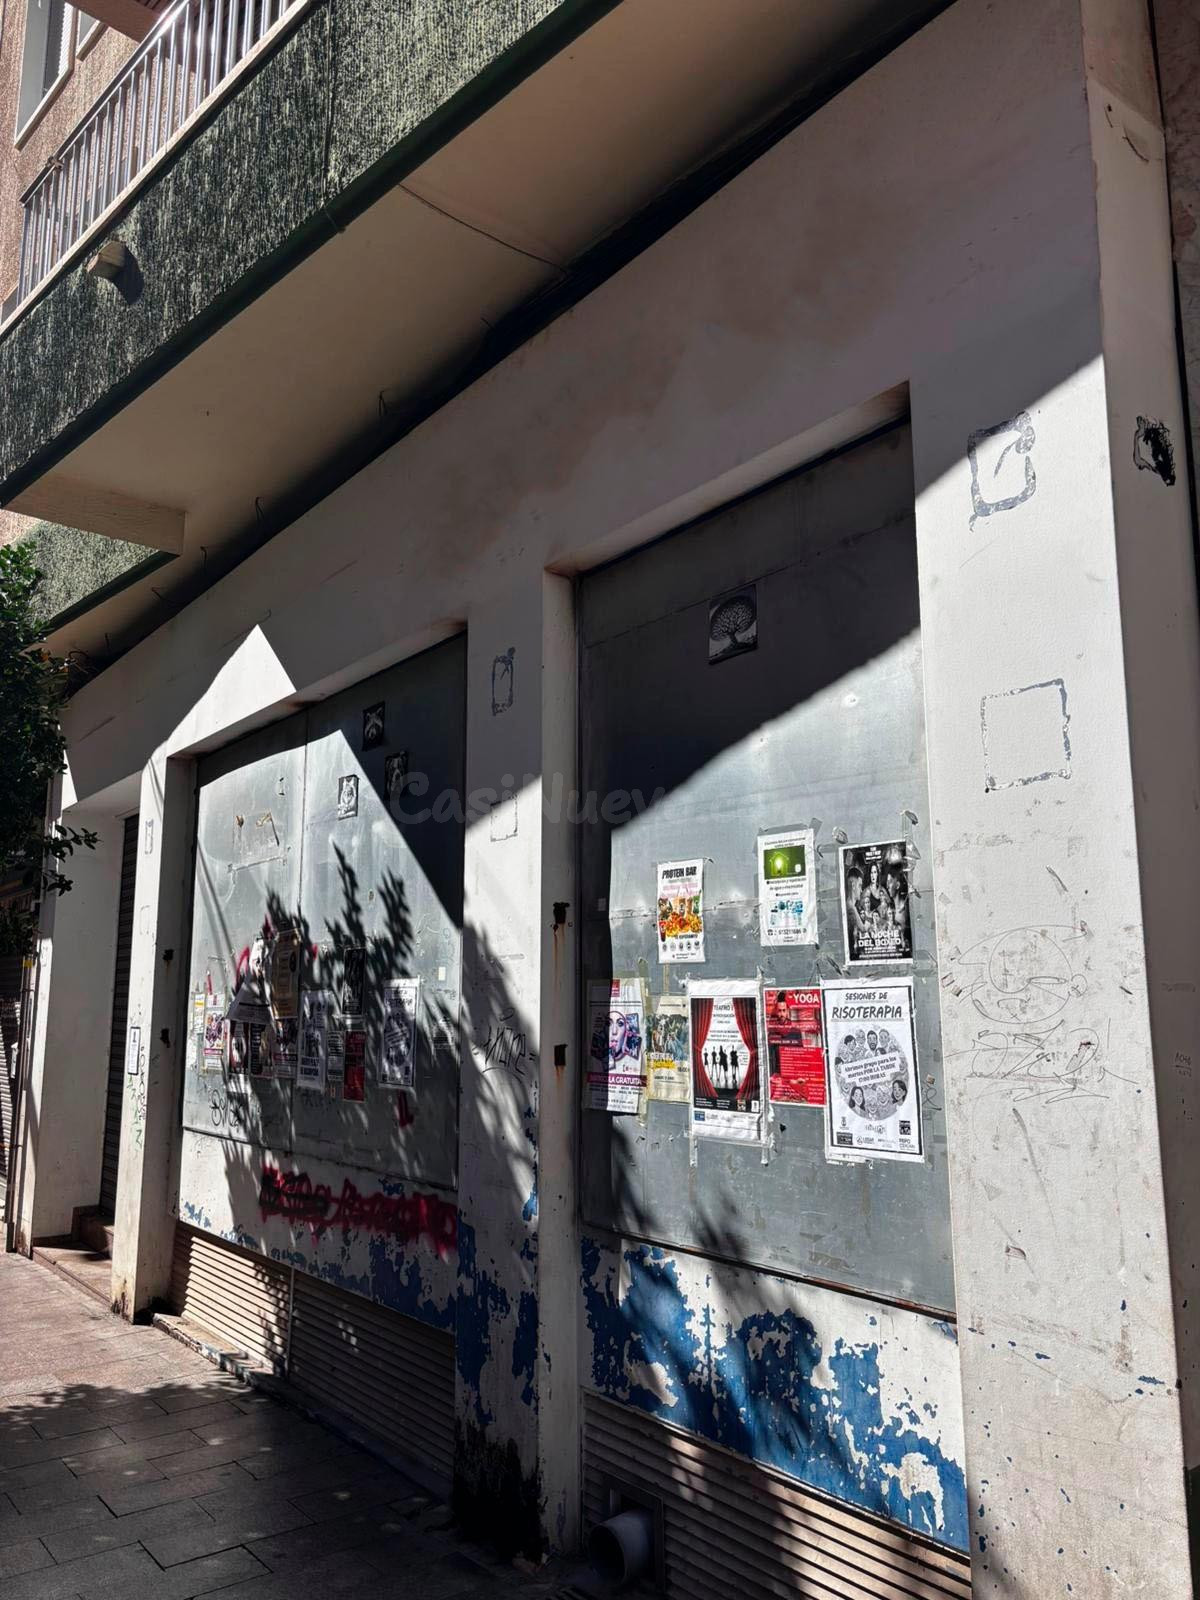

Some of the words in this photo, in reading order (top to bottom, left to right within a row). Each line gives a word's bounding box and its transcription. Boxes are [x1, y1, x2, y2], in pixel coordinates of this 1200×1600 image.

[662, 867, 684, 879] PROTEIN
[686, 866, 697, 876] BAR
[859, 931, 870, 940] LA
[871, 929, 900, 939] NOCHE
[858, 939, 874, 947] DEL
[794, 994, 820, 1003] YOGA
[845, 992, 876, 1000] SESIONES
[879, 992, 888, 1000] DE
[832, 1005, 902, 1019] RISOTERAPIA
